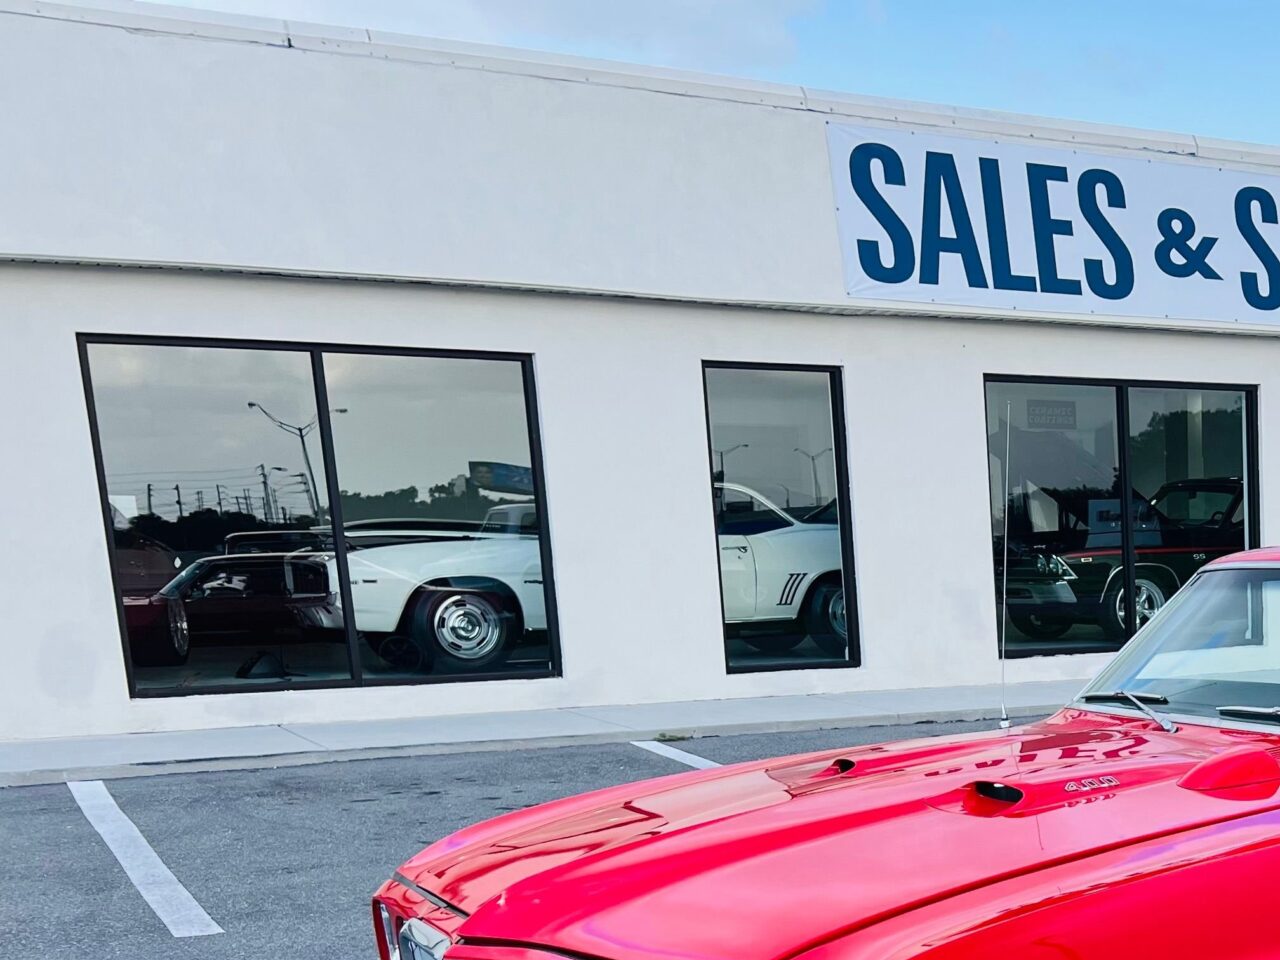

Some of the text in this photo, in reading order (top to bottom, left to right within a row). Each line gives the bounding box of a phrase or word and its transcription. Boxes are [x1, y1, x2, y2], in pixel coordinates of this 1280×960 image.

[848, 142, 1135, 301] SALES
[1154, 207, 1224, 281] &
[1064, 775, 1121, 793] 400
